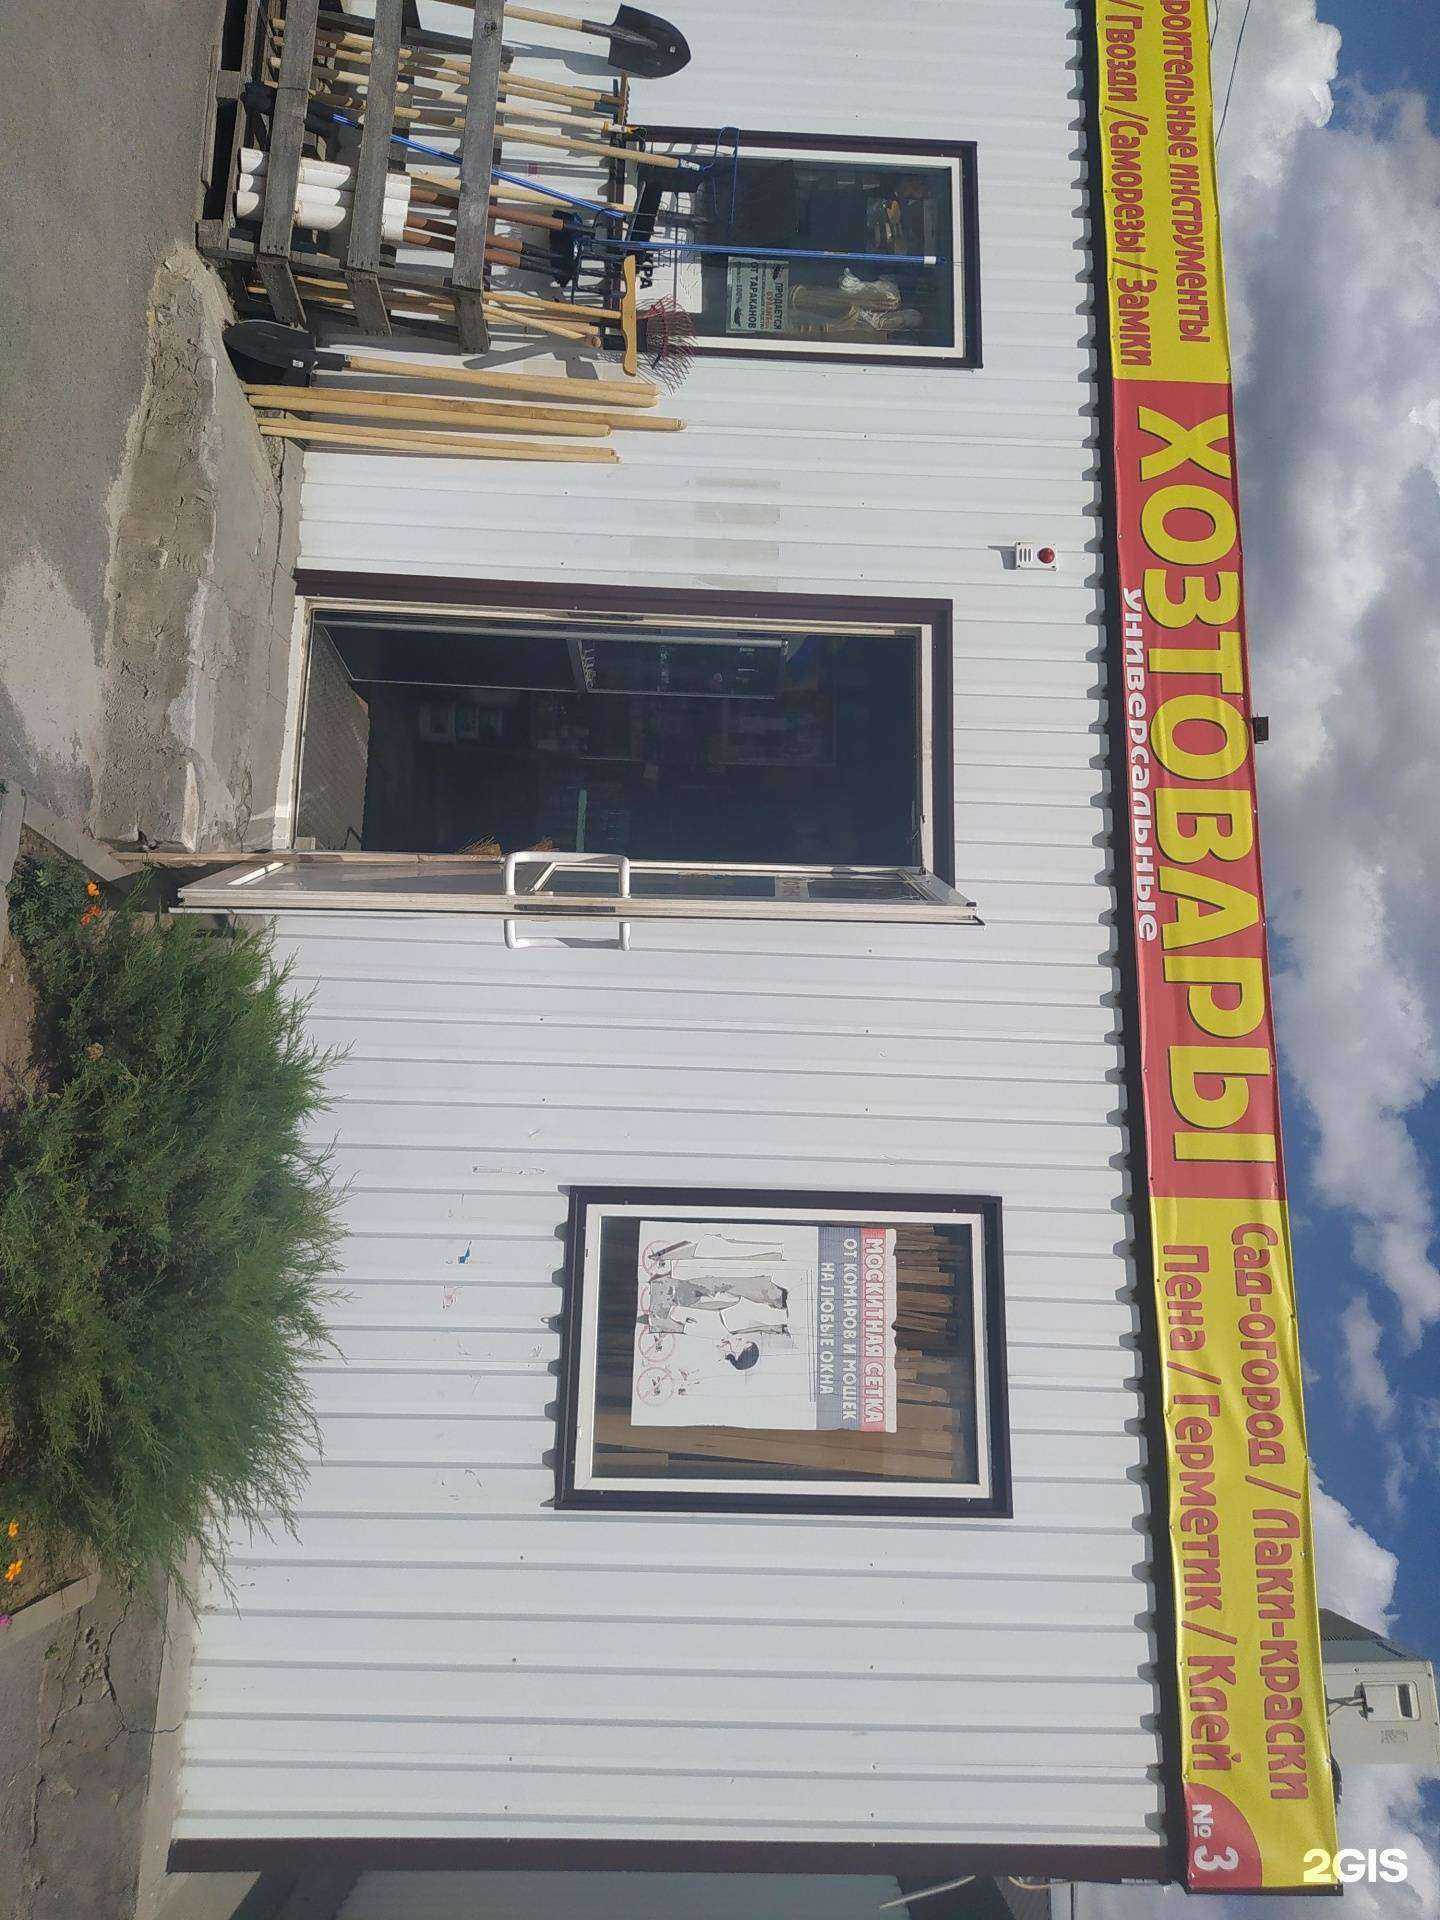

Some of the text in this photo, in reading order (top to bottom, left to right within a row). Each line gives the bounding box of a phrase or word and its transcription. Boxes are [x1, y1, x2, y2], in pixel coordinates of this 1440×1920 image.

[1105, 15, 1143, 102] Гвозди
[747, 276, 758, 329] ТАРАКАНОВ
[1116, 277, 1157, 367] Замки
[1169, 163, 1211, 343] инструменты
[1122, 586, 1158, 943] универсальные
[1137, 405, 1276, 1165] ХОЗТОВАРЫ
[819, 1262, 835, 1395] НА ЛЮБЫЕ ОКНА
[842, 1238, 858, 1421] ОТ КОМАРОВ И МОШЕК
[864, 1237, 885, 1424] МОСКИТНАЯ СЕТКА
[1163, 1244, 1210, 1352] Пена
[1231, 1222, 1286, 1467] Сад-огород
[1174, 1394, 1223, 1611] Герметик
[1187, 1655, 1242, 1771] Клей
[1253, 1508, 1309, 1800] Лаки-краски
[1193, 1845, 1239, 1872] 3
